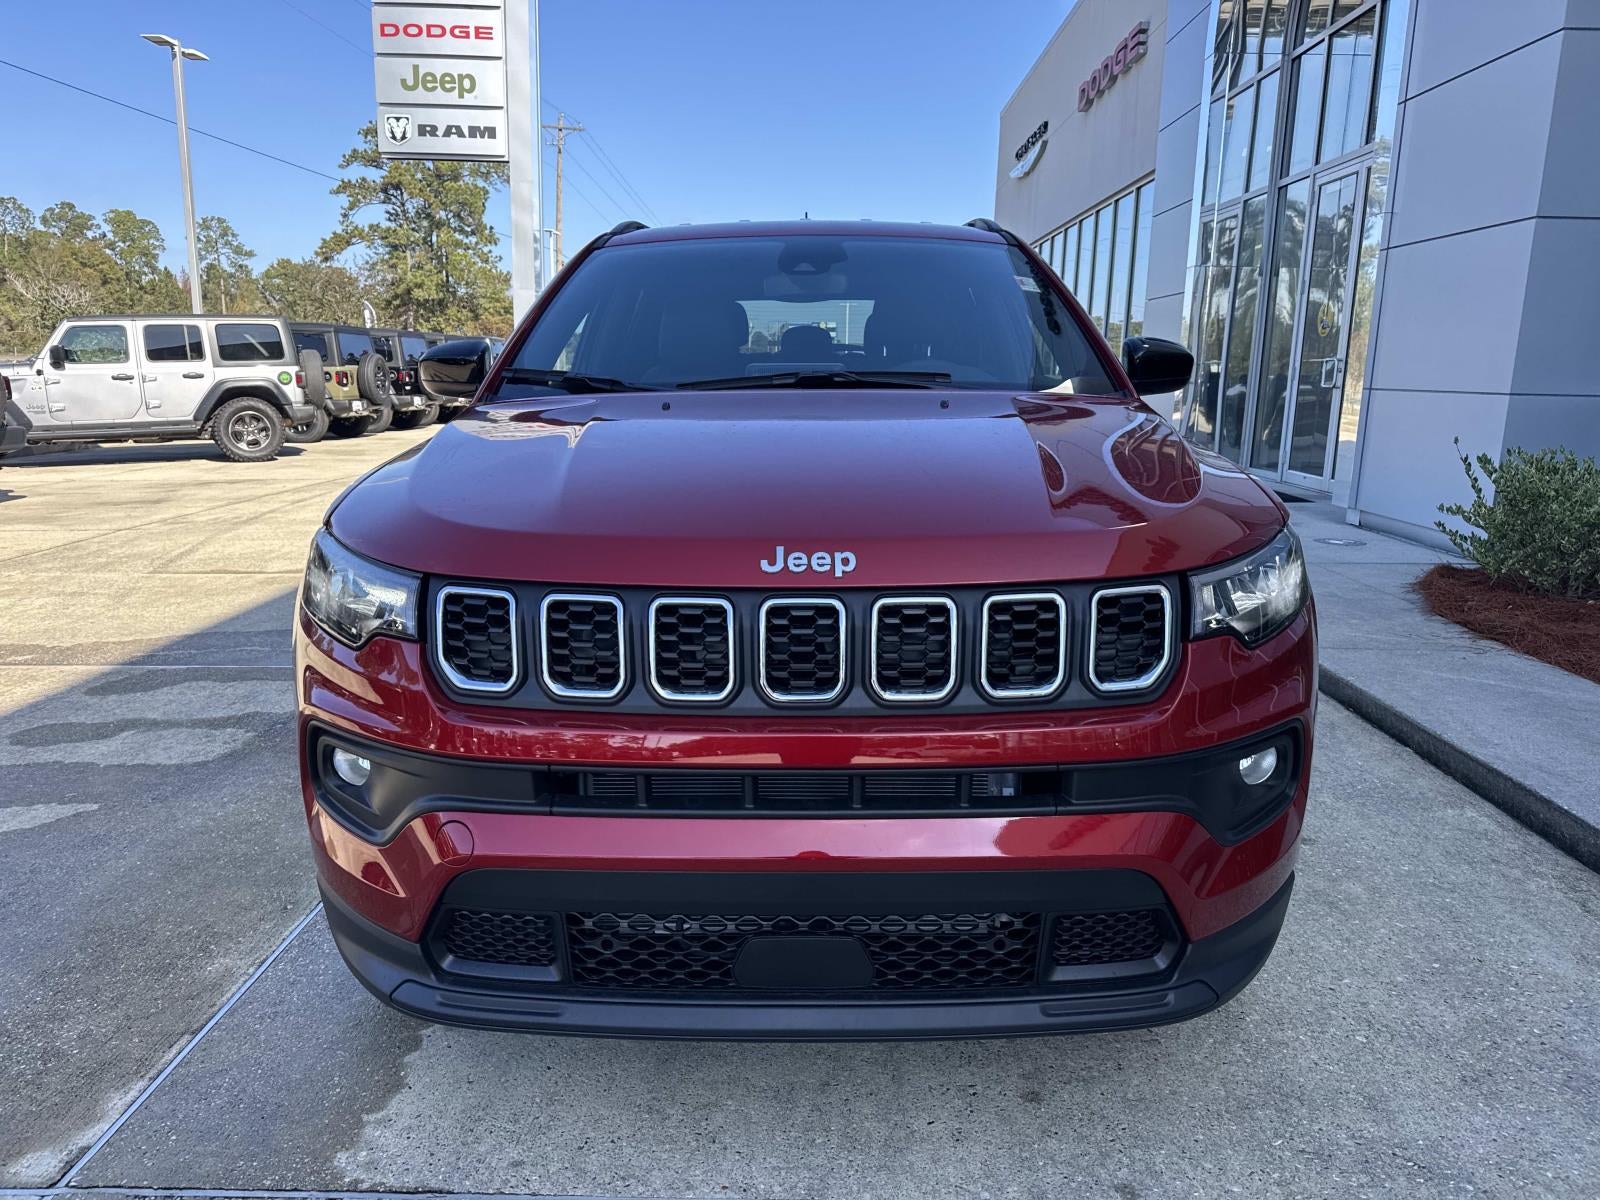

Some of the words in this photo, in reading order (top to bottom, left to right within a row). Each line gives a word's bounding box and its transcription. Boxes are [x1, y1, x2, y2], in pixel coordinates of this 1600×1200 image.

[379, 22, 494, 41] DODGE
[400, 64, 477, 99] Jeep
[1077, 21, 1151, 113] DODGE
[417, 123, 497, 139] RAM
[760, 545, 857, 577] Jeep
